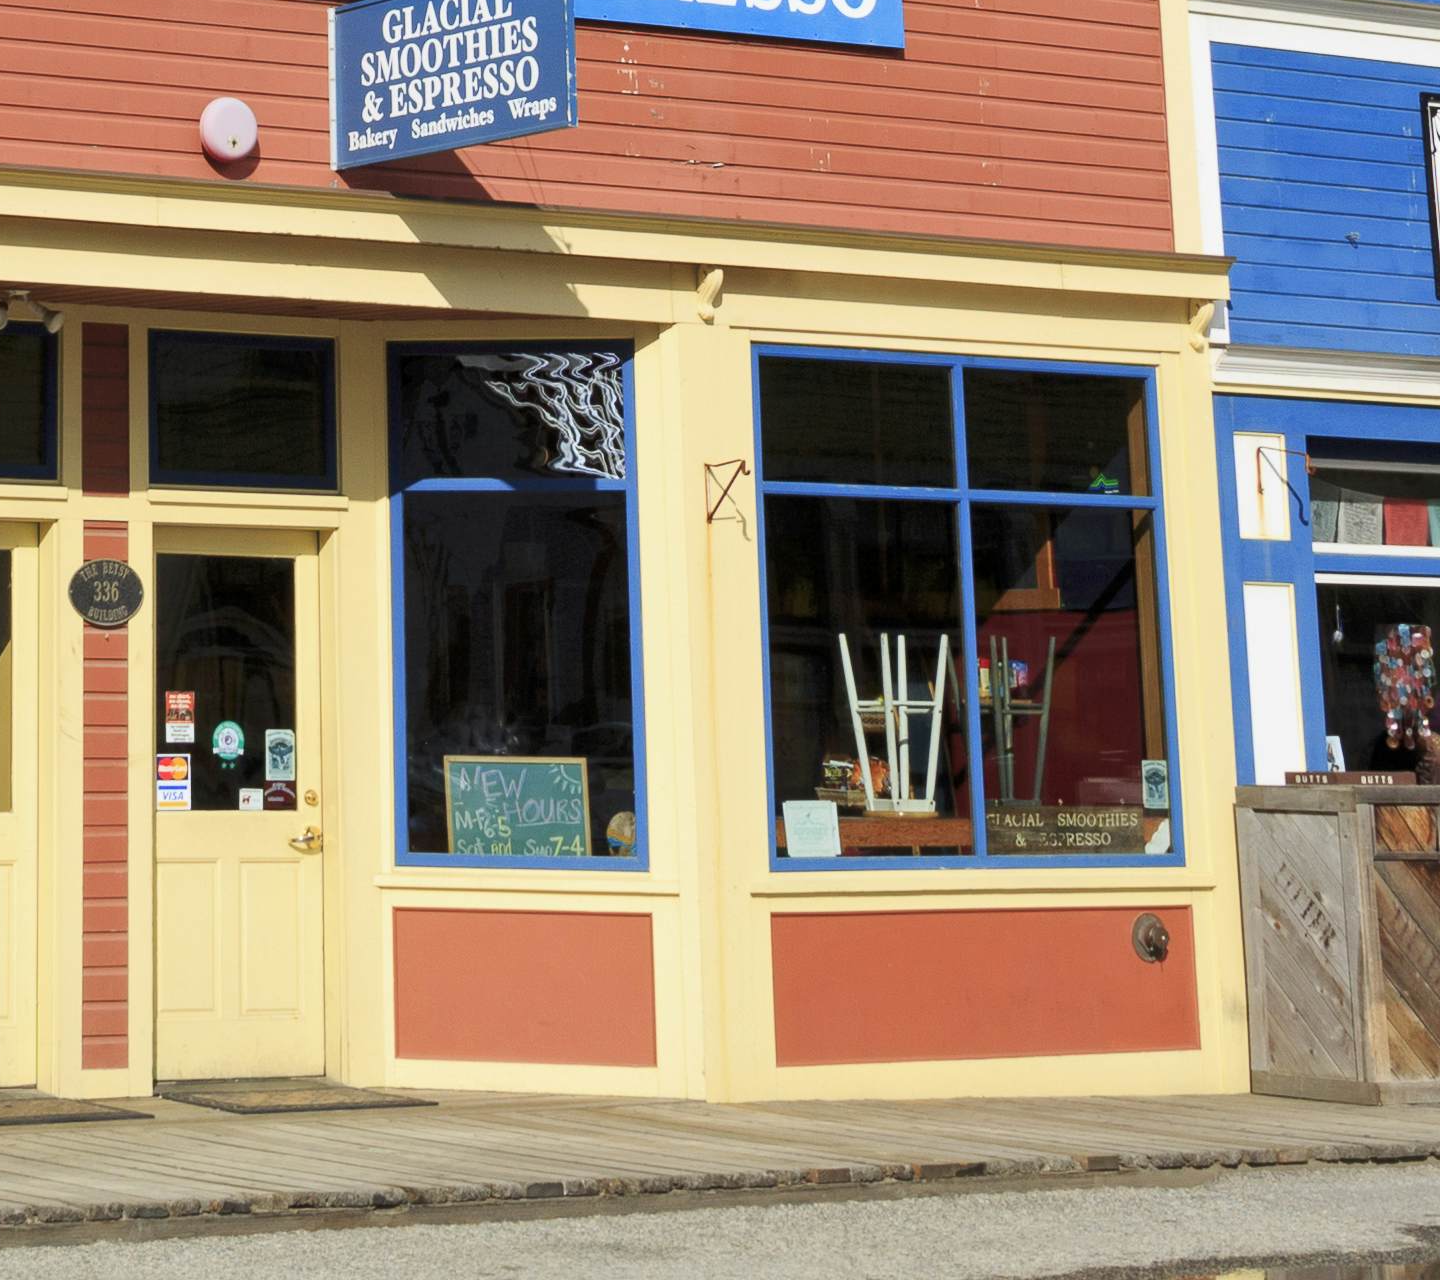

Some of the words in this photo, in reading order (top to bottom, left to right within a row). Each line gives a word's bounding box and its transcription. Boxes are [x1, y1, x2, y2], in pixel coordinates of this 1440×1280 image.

[360, 16, 539, 87] SMOOTHIES
[361, 90, 384, 123] &
[389, 55, 540, 118] ESPRESSO
[348, 126, 399, 152] Bakery
[410, 108, 495, 139] Sandwiches
[507, 95, 558, 121] Wraps
[79, 563, 98, 582] THE
[93, 580, 119, 603] 336
[87, 605, 129, 622] BUILDING
[458, 765, 528, 799] NEW
[162, 791, 184, 801] VISA
[503, 798, 582, 824] HOURS
[1057, 812, 1138, 828] SMOOTHIES
[1015, 832, 1027, 847] &
[1274, 862, 1337, 950] LITTER
